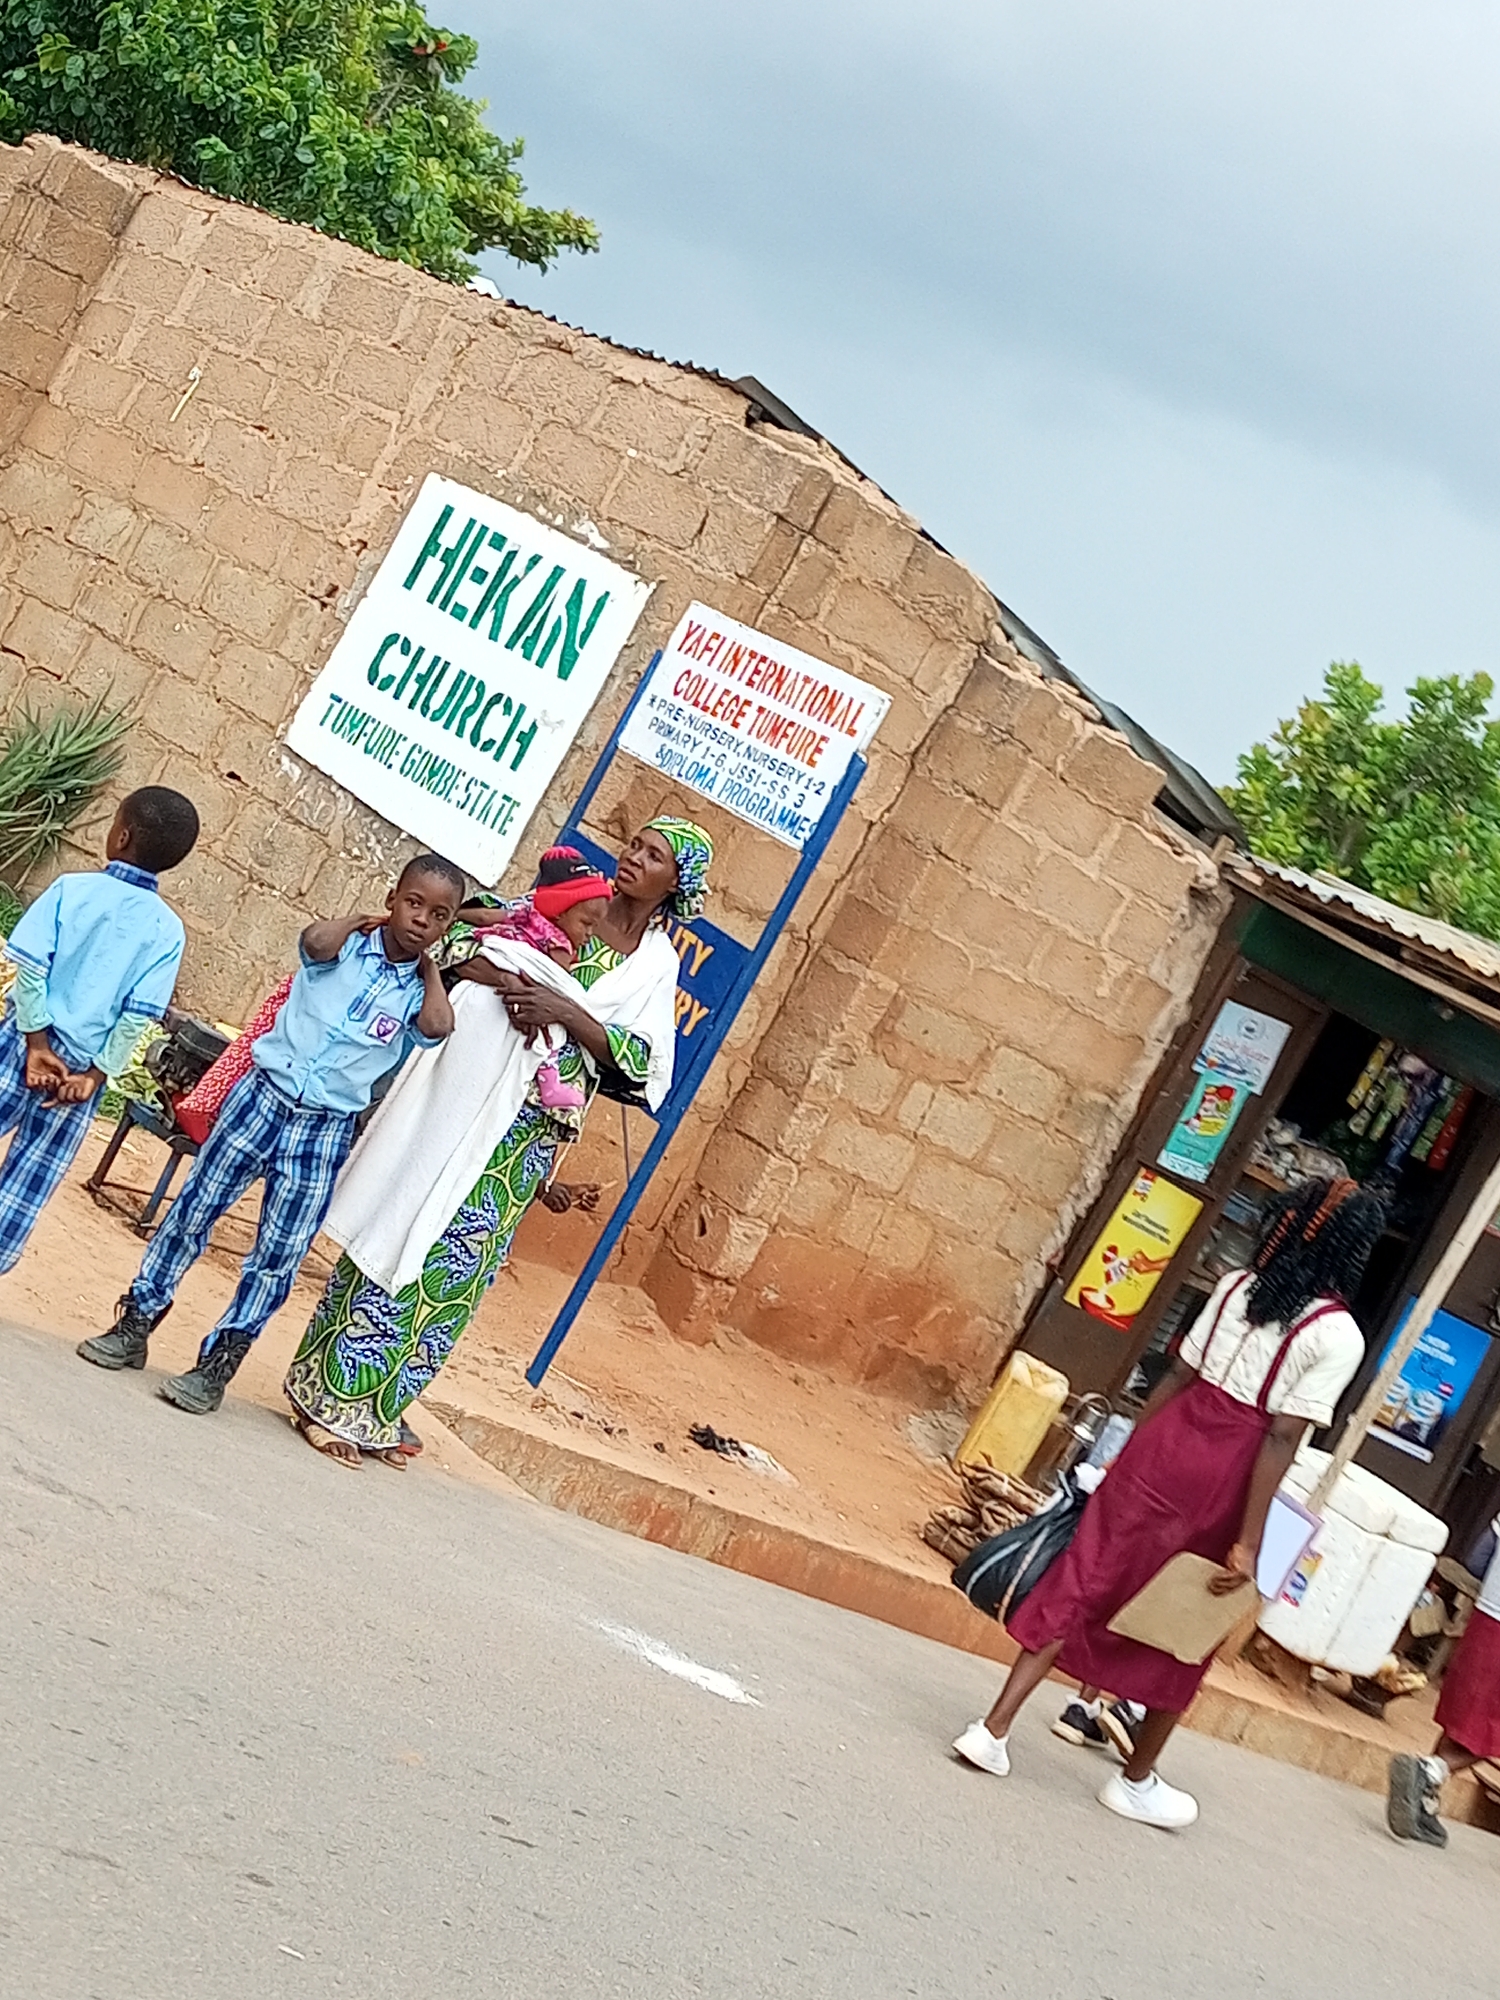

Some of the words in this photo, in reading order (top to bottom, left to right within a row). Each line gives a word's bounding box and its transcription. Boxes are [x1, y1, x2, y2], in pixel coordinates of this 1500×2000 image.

[402, 504, 611, 682] HEKAN
[367, 633, 539, 772] CHURCH
[673, 669, 753, 730] COLLEGE
[747, 705, 830, 769] TUMFURE
[677, 621, 727, 667] YAFI
[722, 640, 866, 738] INTERNATIONAL
[456, 776, 521, 837] STATE
[803, 776, 827, 797] 1-2
[675, 985, 710, 1037] RY
